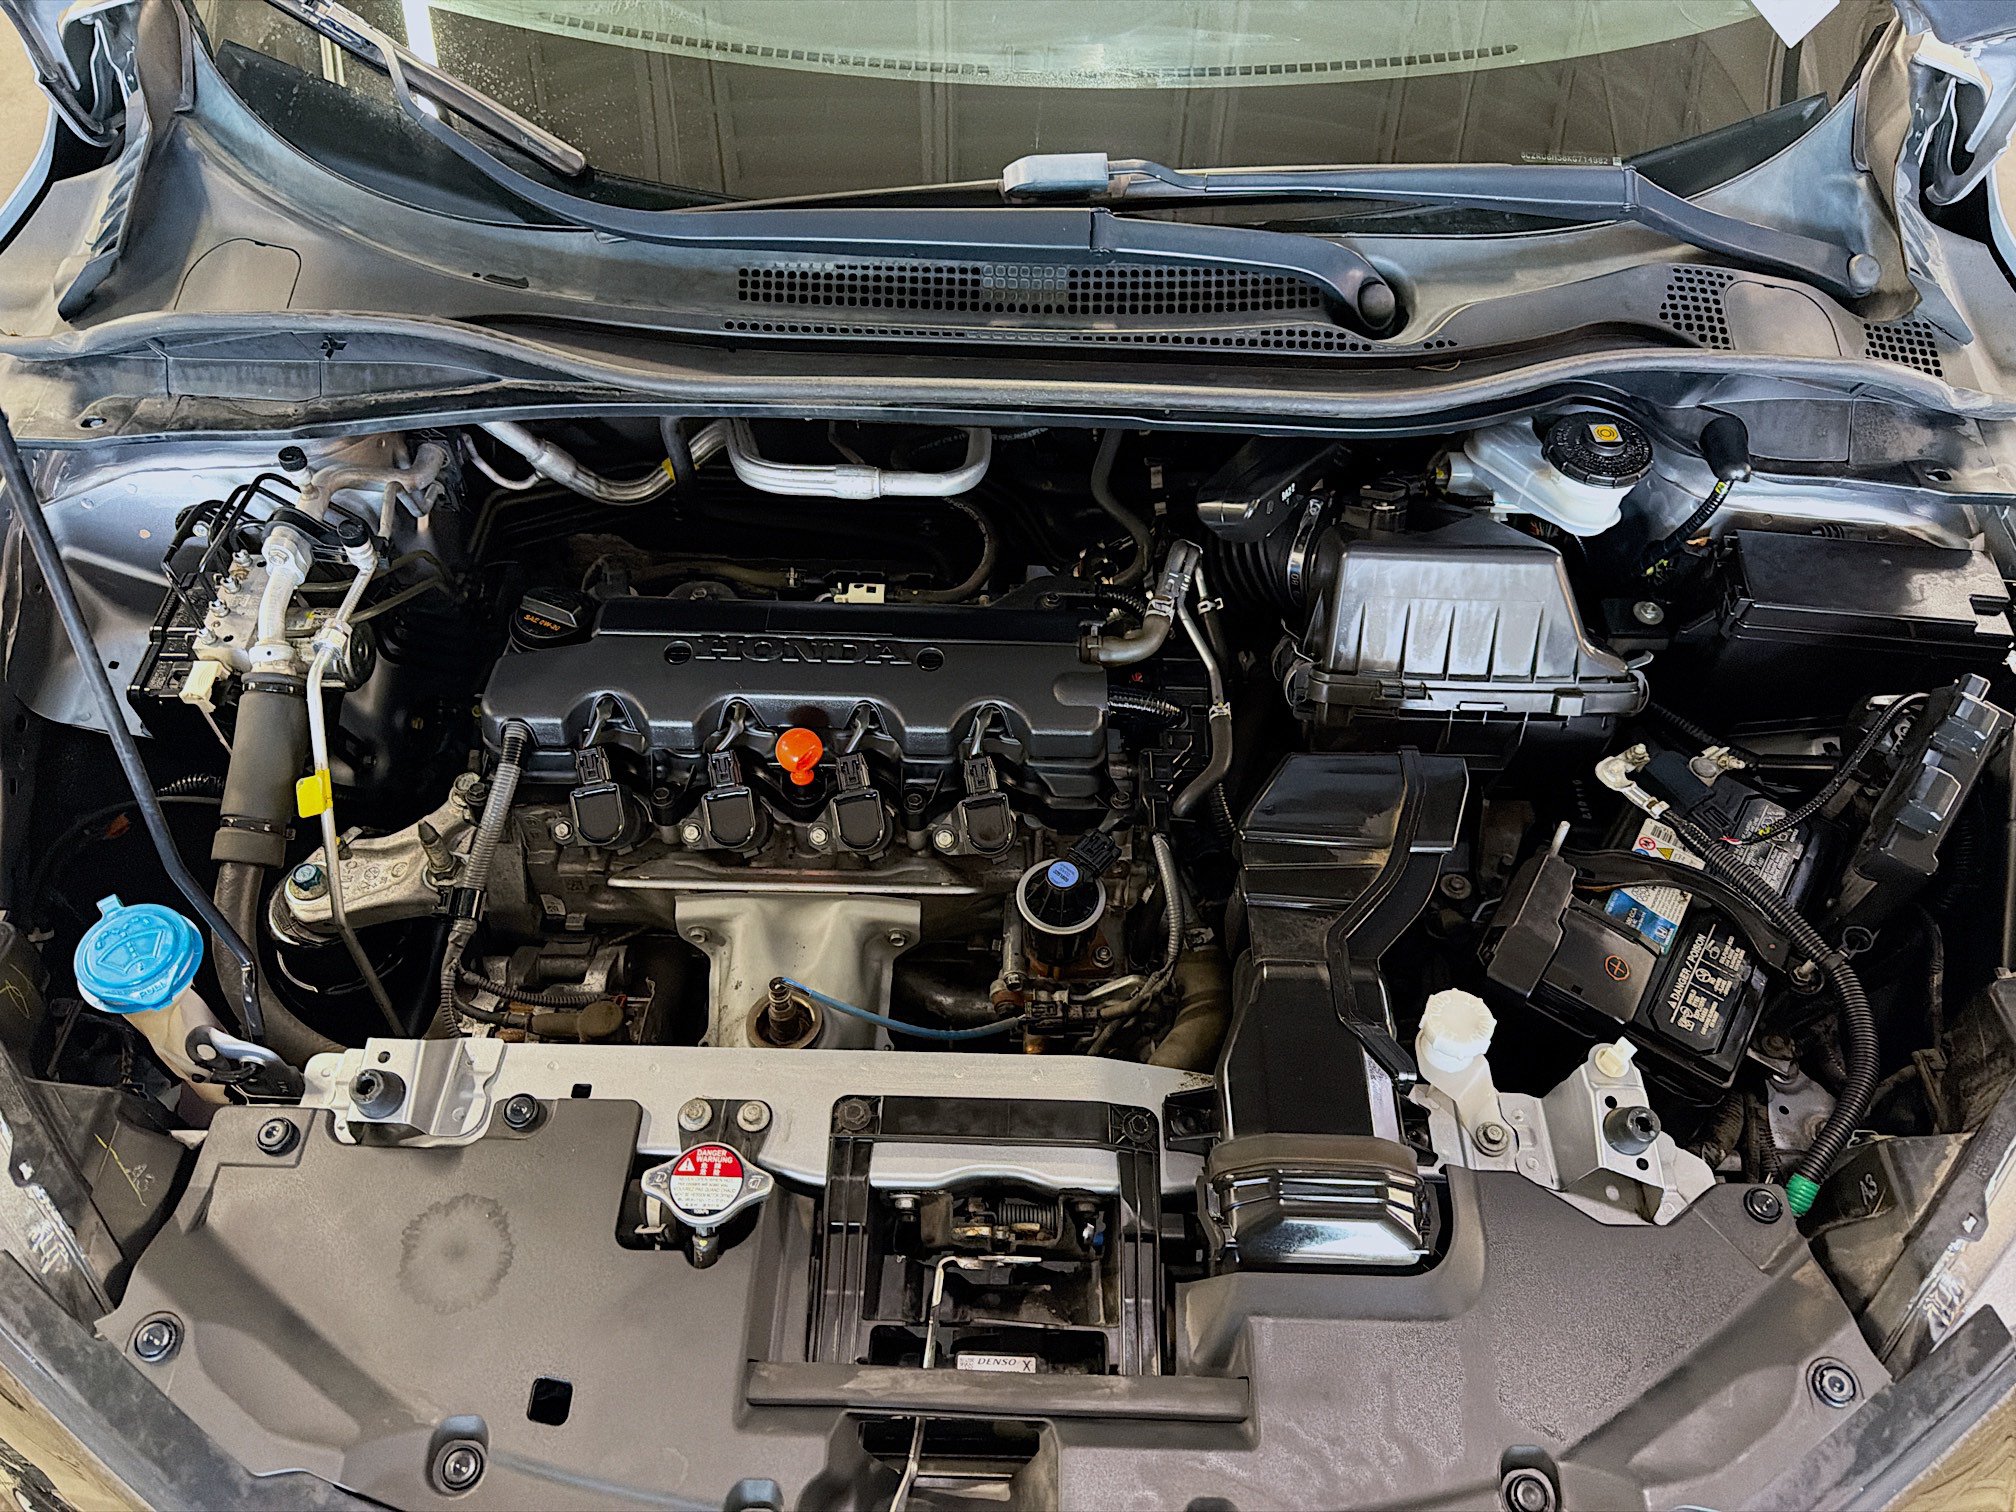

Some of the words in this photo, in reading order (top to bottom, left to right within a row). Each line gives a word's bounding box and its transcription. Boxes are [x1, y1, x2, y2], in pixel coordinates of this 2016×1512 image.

[523, 614, 540, 624] SAE
[693, 638, 913, 666] HONDA
[1670, 967, 1691, 1000] DANGER
[1688, 933, 1707, 962] POISON
[138, 981, 168, 1000] PULL
[696, 1149, 727, 1157] DANGER
[696, 1155, 733, 1164] WARNUNG
[977, 1357, 1017, 1366] DENSO
[1022, 1360, 1032, 1371] X
